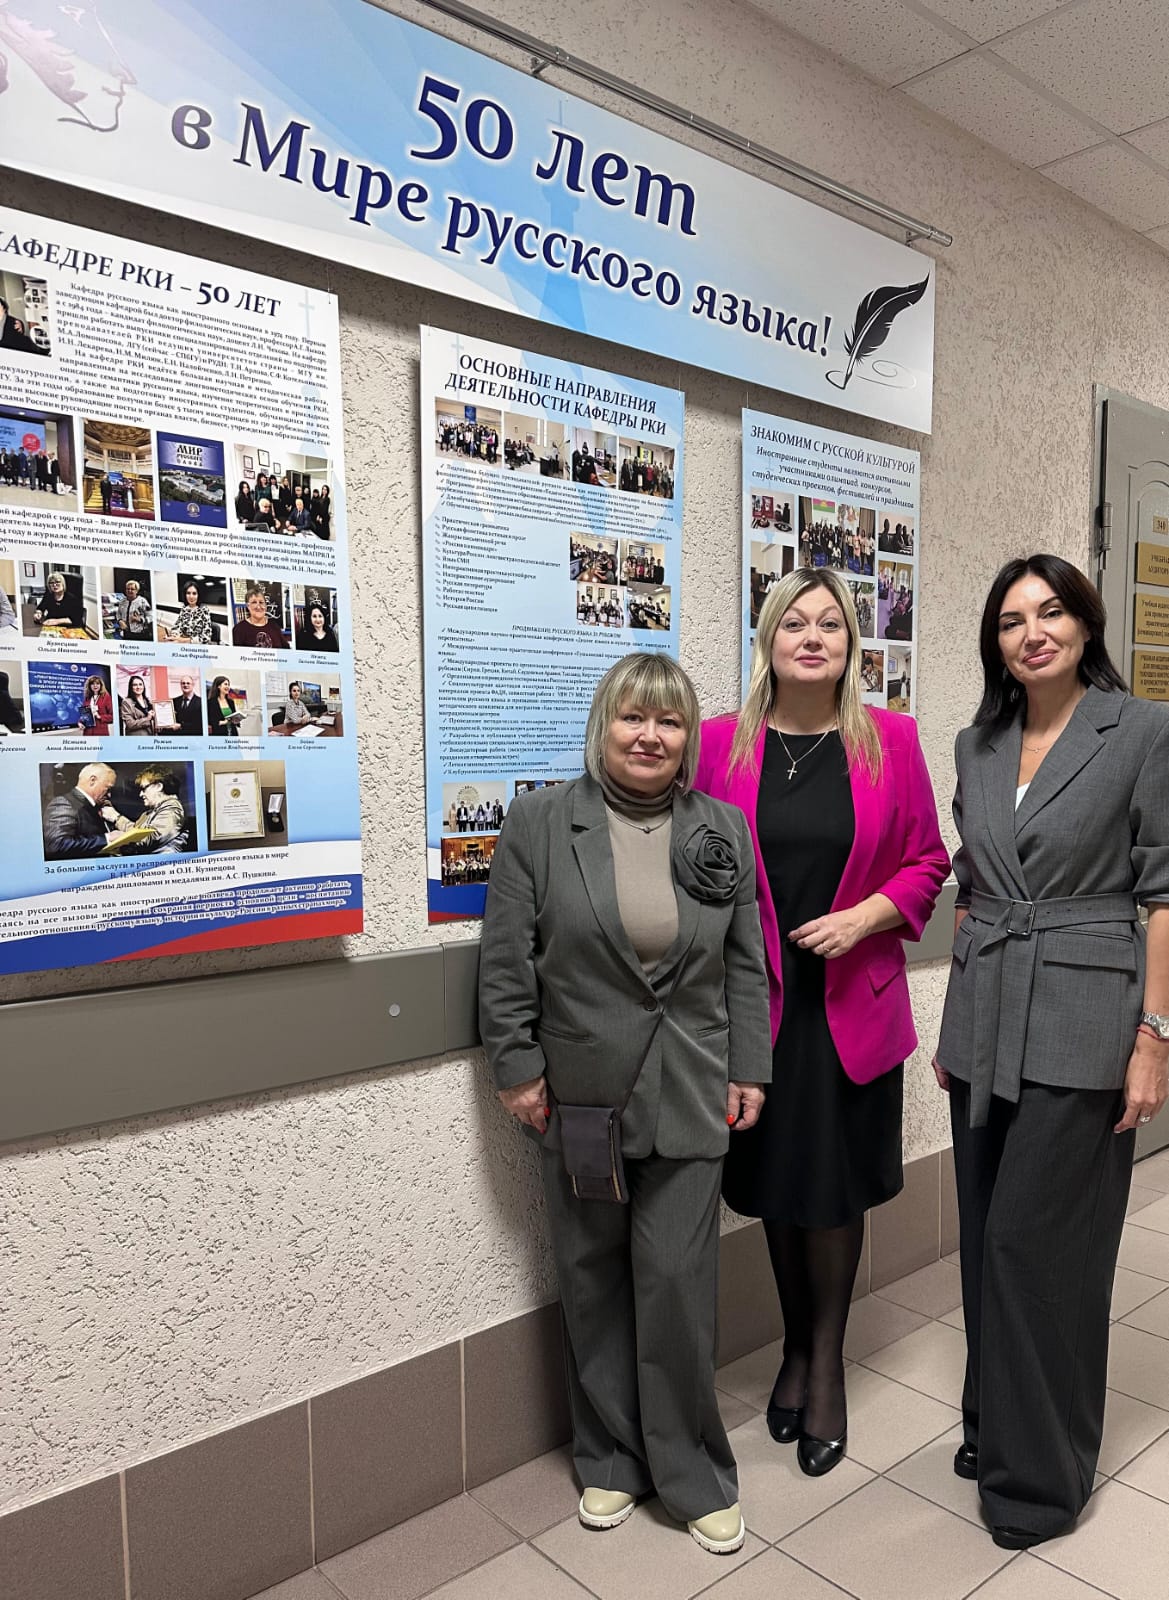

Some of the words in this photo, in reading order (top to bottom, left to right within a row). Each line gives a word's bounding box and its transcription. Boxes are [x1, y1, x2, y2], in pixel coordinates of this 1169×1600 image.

[410, 76, 513, 160] 50
[537, 130, 697, 235] лет
[172, 104, 212, 150] в
[233, 103, 428, 225] Мире
[442, 196, 681, 306] русского
[693, 285, 831, 357] языка!
[0, 232, 112, 276] АФЕДРЕ
[121, 262, 172, 291] РКИ
[197, 282, 229, 305] 50
[235, 292, 281, 316] ЛЕТ
[71, 283, 104, 296] Кафедра
[107, 293, 140, 304] русского
[142, 301, 164, 310] языка
[182, 311, 230, 325] иностранного
[106, 302, 142, 314] кафедрой
[57, 310, 89, 320] пришли
[91, 317, 124, 328] работать
[126, 325, 171, 338] выпускники
[57, 319, 132, 338] преподавателей
[136, 334, 154, 343] РКИ
[110, 312, 144, 323] кандидат
[147, 319, 205, 337] филологических
[75, 349, 86, 357] На
[89, 354, 123, 365] кафедре
[127, 360, 144, 368] РКИ
[100, 374, 140, 385] семантики
[143, 382, 174, 392] русского
[460, 355, 551, 388] ОСНОВНЫЕ
[555, 378, 656, 413] НАПРАВЛЕНИЯ
[25, 389, 59, 399] высокие
[114, 404, 136, 412] посты
[43, 382, 62, 390] годы
[65, 386, 114, 399] образование
[117, 395, 152, 406] получили
[155, 401, 174, 410] более
[445, 373, 569, 413] ДЕЯТЕЛЬНОСТИ
[574, 402, 637, 428] КАФЕДРЫ
[641, 418, 666, 435] РКИ
[177, 444, 203, 456] МИР
[751, 426, 811, 450] ЗНАКОМИМ
[813, 441, 820, 452] С
[822, 442, 864, 462] РУССКОЙ
[866, 453, 915, 474] КУЛЬТУРОЙ
[757, 446, 807, 464] Иностранные
[808, 460, 842, 472] студенты
[752, 471, 800, 486] студенческих
[779, 465, 825, 480] участниками
[12, 510, 51, 519] кафедрой
[101, 519, 133, 528] Валерий
[135, 522, 169, 532] Петрович
[8, 529, 25, 537] году
[125, 530, 147, 538] КубГУ
[143, 550, 164, 558] КубГУ
[196, 865, 235, 874] Кузнецова
[208, 856, 240, 864] русского
[61, 883, 114, 895] награждены
[116, 880, 163, 889] дипломами
[28, 907, 67, 916] русского
[121, 896, 179, 908] иностранного
[63, 914, 98, 922] вызовы
